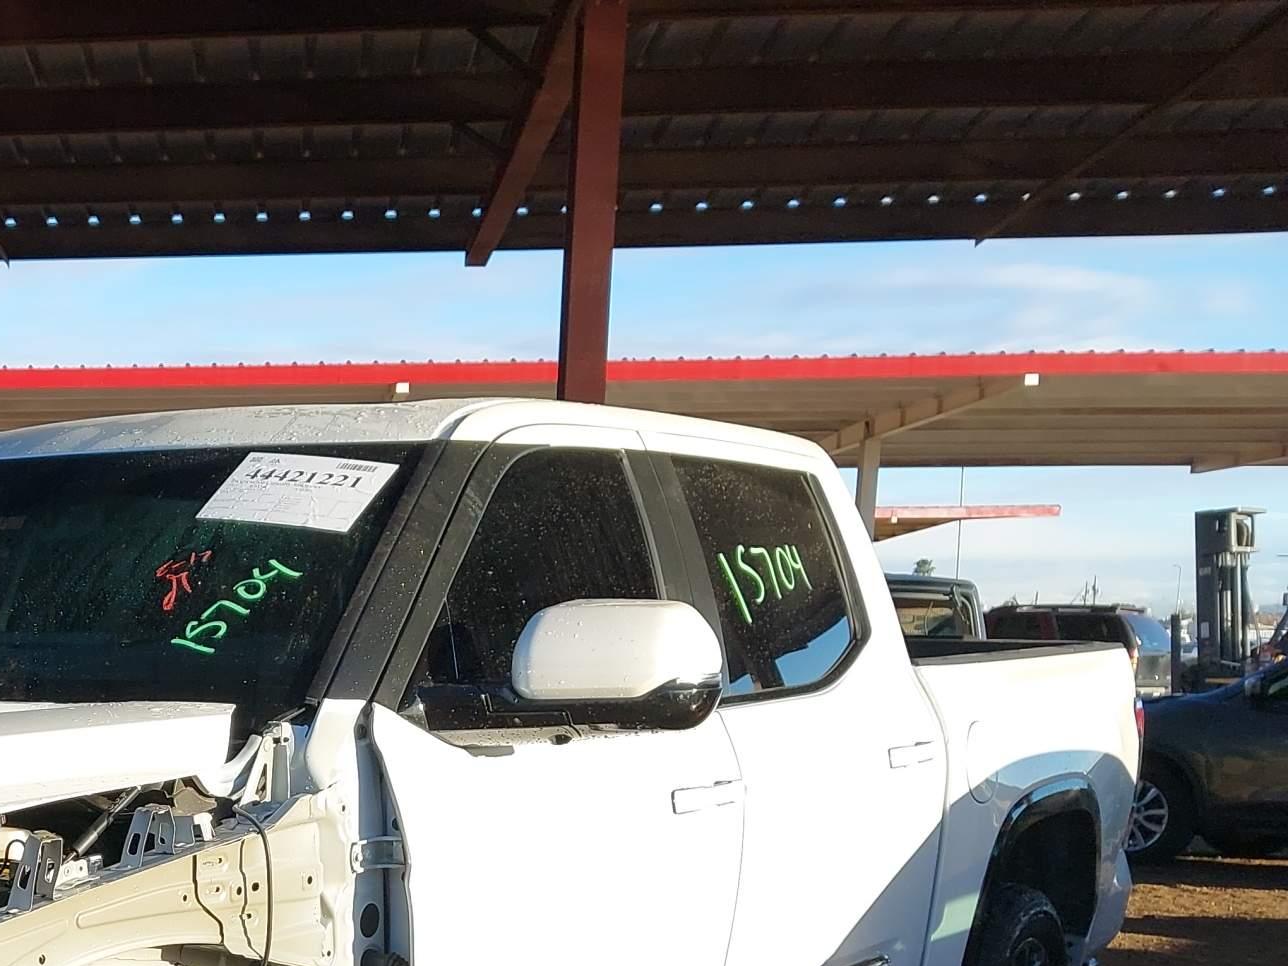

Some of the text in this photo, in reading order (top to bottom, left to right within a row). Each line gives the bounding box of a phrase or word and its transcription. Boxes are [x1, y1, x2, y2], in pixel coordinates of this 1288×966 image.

[244, 468, 363, 488] 44421221
[170, 558, 304, 654] 15704
[717, 544, 813, 624] 15704
